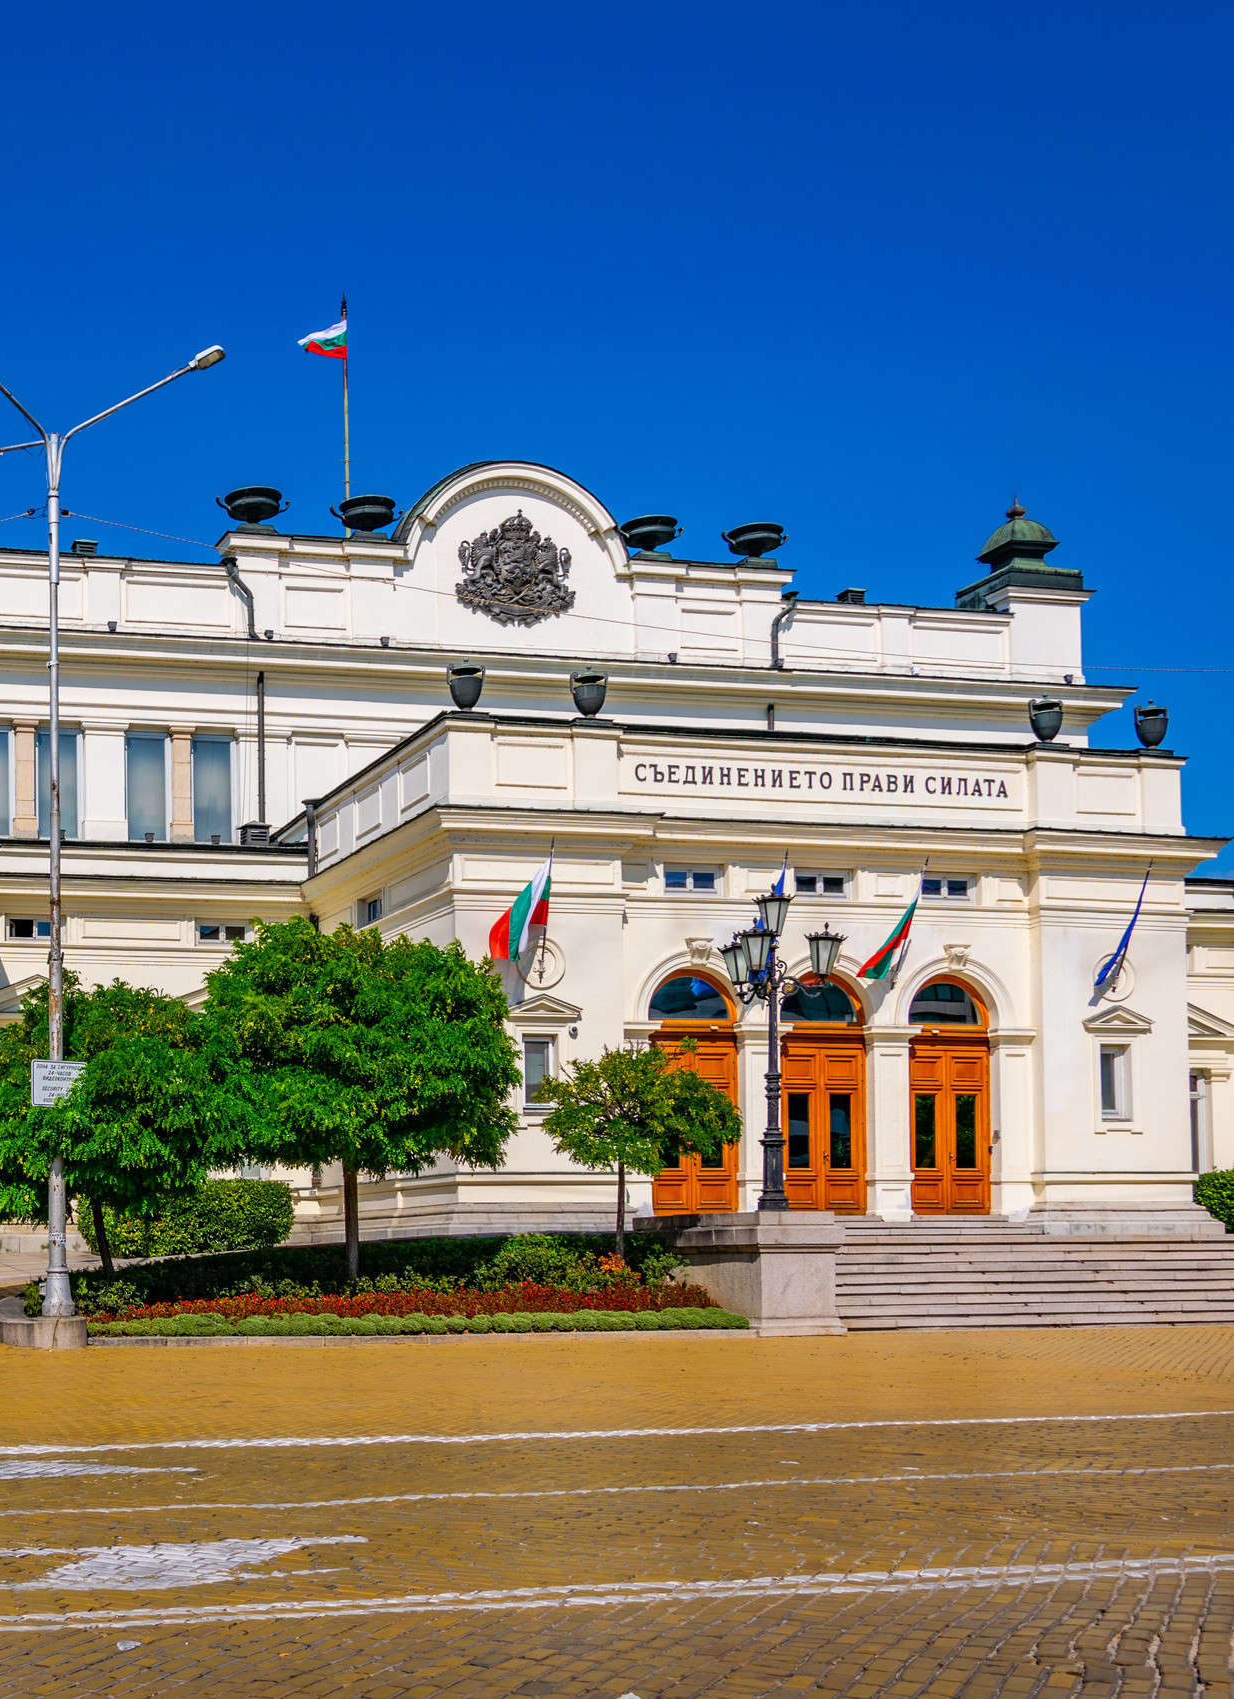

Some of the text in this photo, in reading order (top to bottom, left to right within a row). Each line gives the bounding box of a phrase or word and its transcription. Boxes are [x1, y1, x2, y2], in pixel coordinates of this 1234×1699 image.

[634, 763, 1009, 798] СЪЕДИНЕНИЕТО ПРАВИ СИЛАТА
